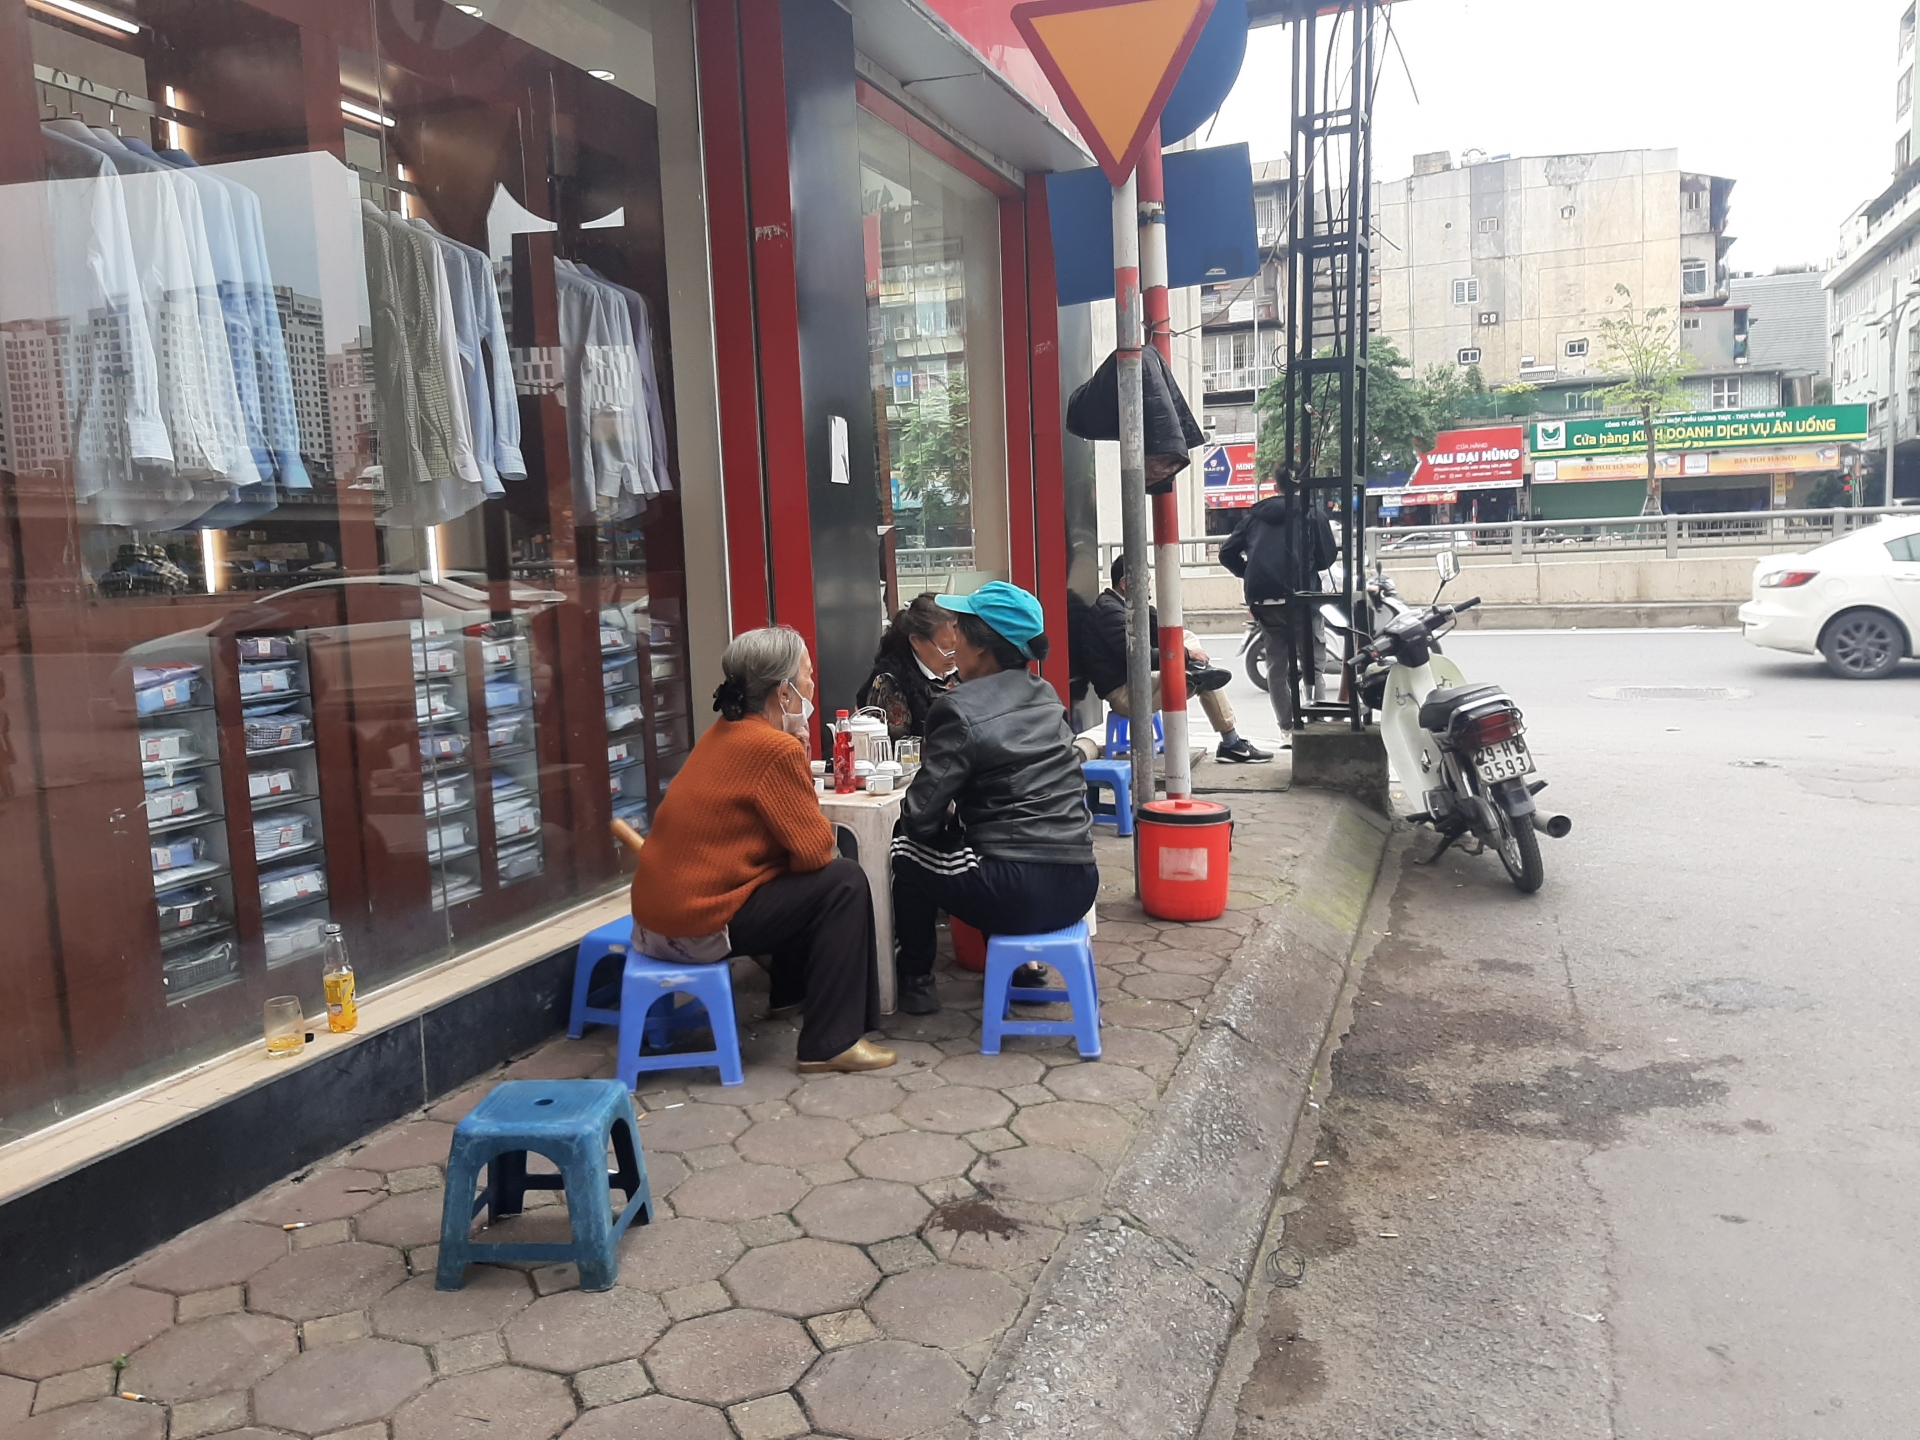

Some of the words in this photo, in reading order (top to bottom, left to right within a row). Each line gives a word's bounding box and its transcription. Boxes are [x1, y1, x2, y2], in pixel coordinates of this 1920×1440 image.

[1573, 433, 1597, 446] Cửa
[1599, 431, 1630, 446] hàng
[1666, 425, 1714, 439] DOANH
[1717, 424, 1748, 439] DỊCH
[1750, 422, 1771, 438] VỤ
[1772, 419, 1793, 434] ĂN
[1795, 415, 1837, 433] UỐNG
[1426, 453, 1454, 466] VALI
[1456, 451, 1479, 465] ĐẠI
[1484, 756, 1527, 781] 9593
